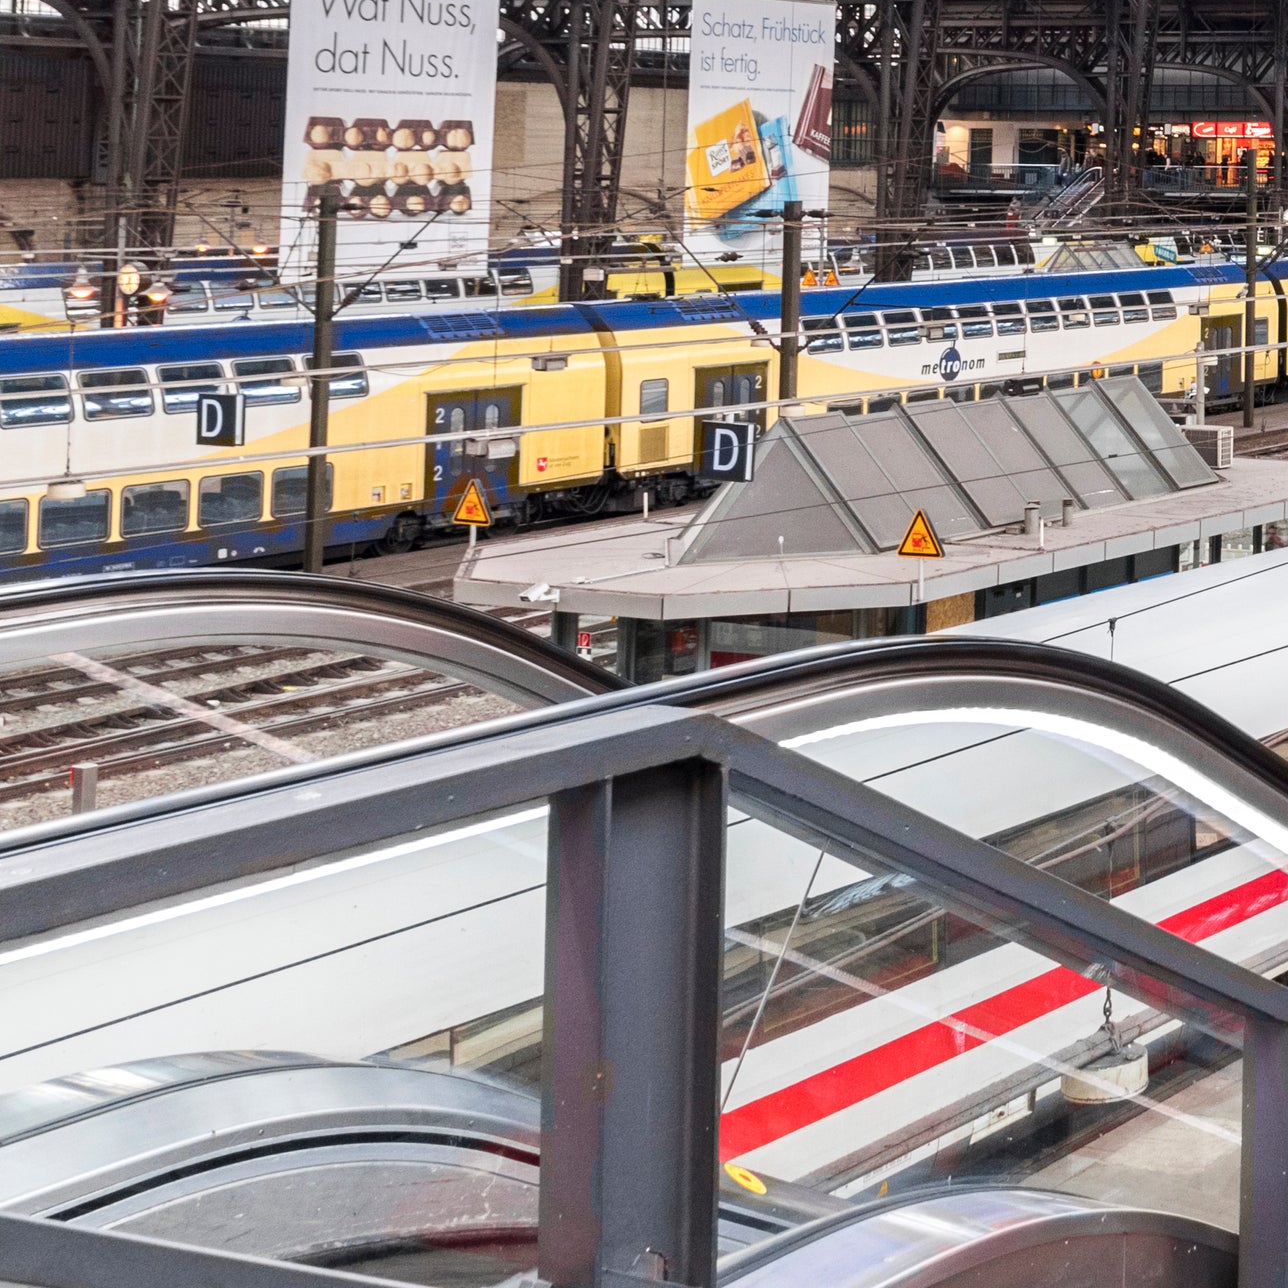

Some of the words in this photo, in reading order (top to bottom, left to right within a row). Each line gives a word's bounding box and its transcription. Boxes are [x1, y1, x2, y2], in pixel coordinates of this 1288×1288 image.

[702, 12, 758, 44] Schatz,
[761, 17, 826, 44] Frühstück
[315, 31, 371, 74] dat
[381, 38, 459, 79] Nuss.
[701, 50, 715, 72] ist
[720, 46, 761, 82] fertig.
[754, 375, 762, 390] 2
[921, 358, 986, 375] metronom
[201, 398, 223, 438] D
[435, 407, 445, 424] 2
[713, 428, 739, 472] D
[433, 465, 443, 481] 2
